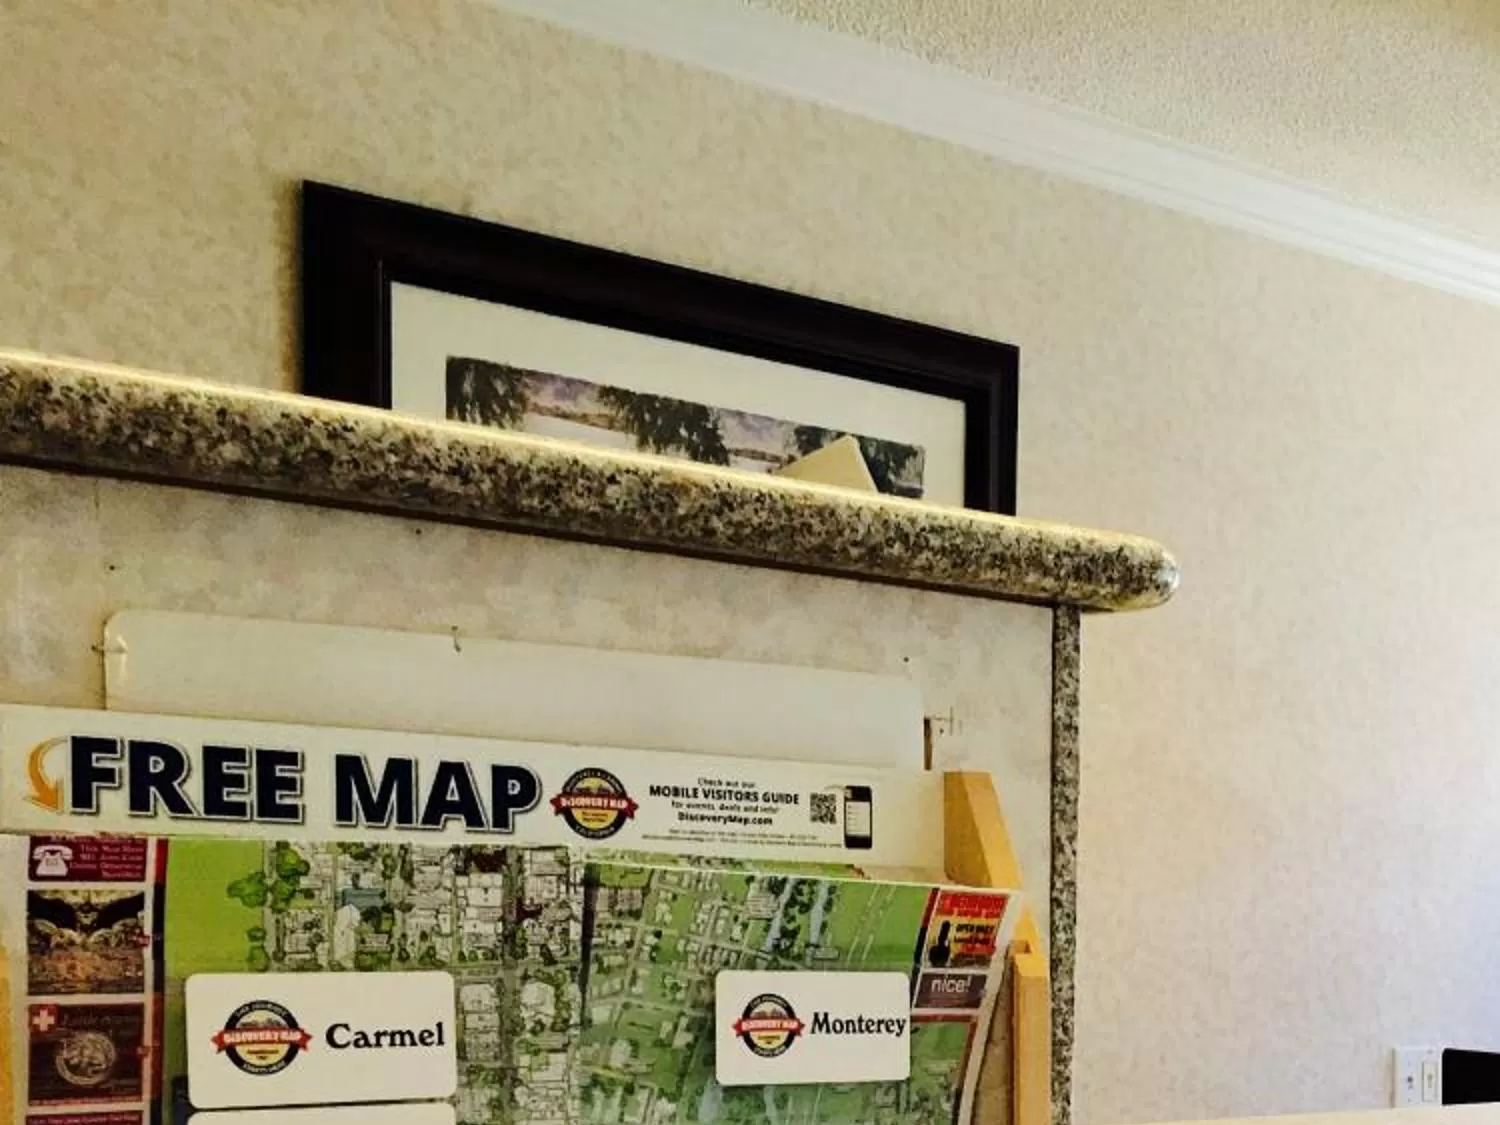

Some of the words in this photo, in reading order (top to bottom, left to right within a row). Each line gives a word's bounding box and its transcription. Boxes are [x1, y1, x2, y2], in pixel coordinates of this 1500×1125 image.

[69, 735, 305, 824] FREE
[335, 753, 541, 834] MAP
[650, 785, 699, 798] MOBILE
[701, 788, 759, 802] VISITORS
[762, 791, 800, 805] GUIDE
[931, 975, 971, 994] nice!
[325, 1021, 445, 1049] Carmel
[810, 1012, 907, 1037] Monterey
